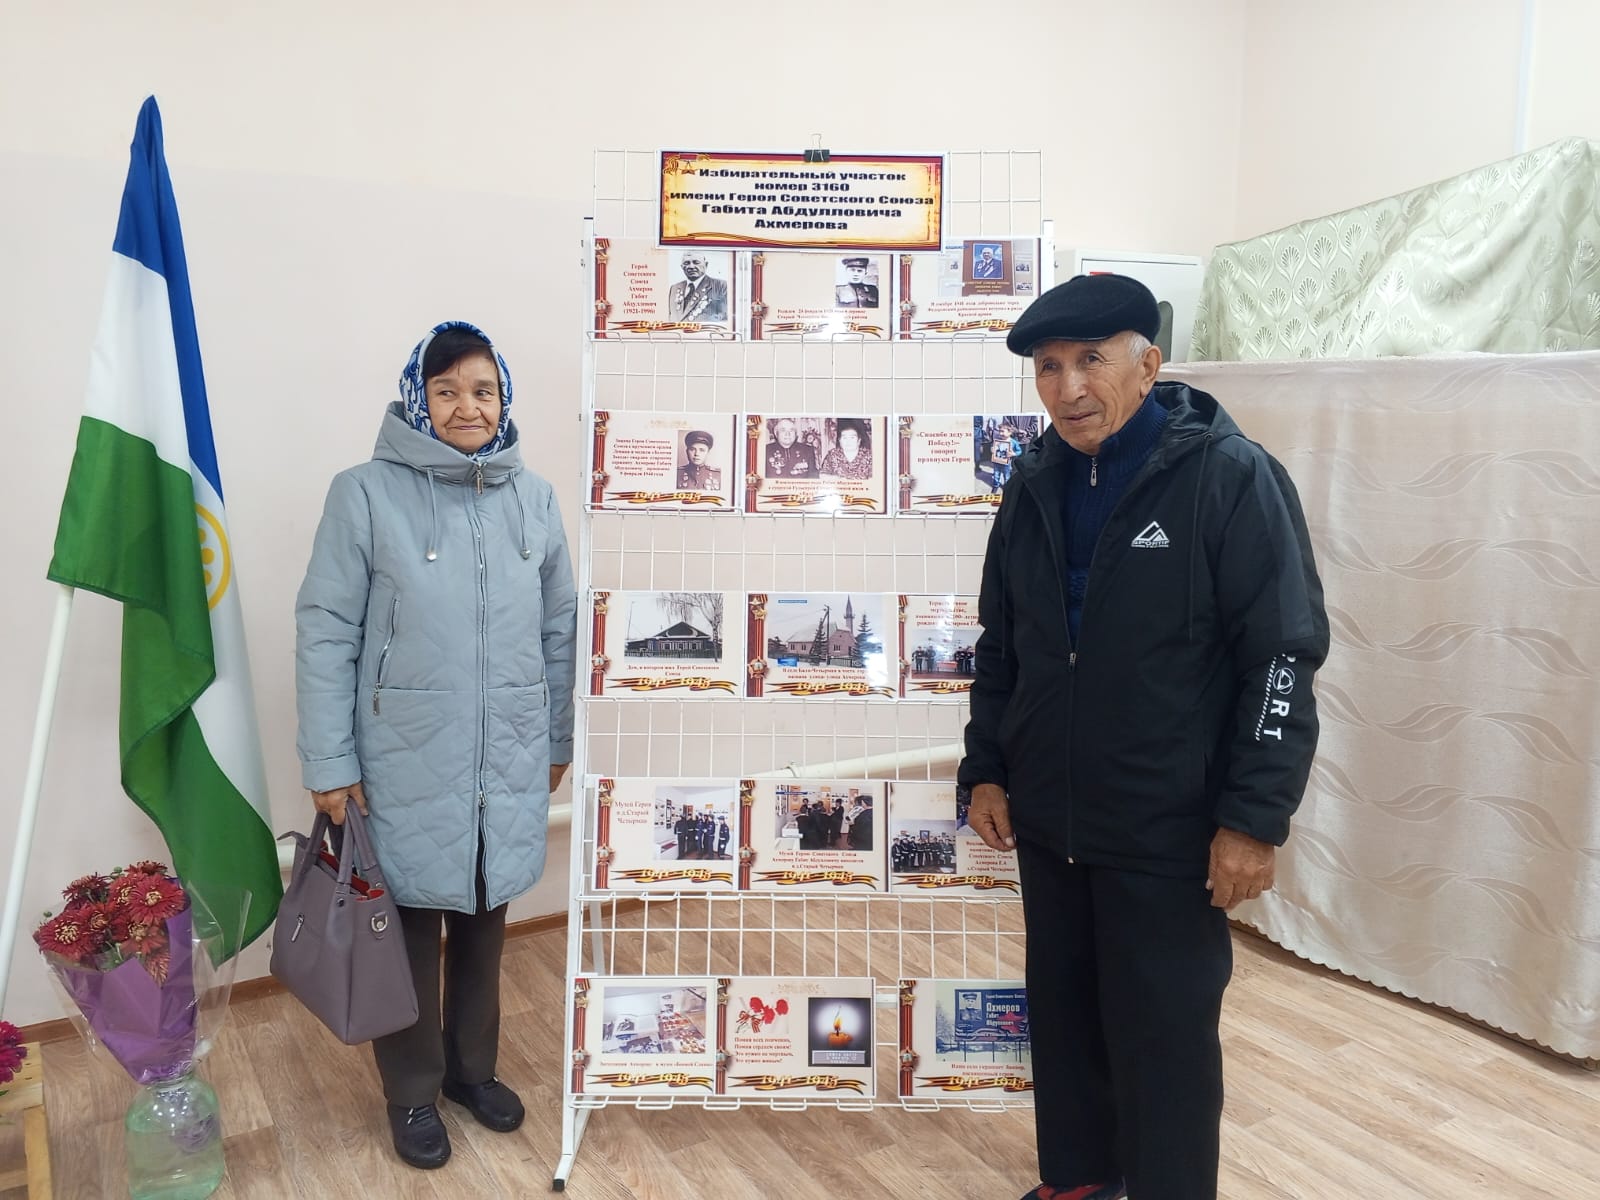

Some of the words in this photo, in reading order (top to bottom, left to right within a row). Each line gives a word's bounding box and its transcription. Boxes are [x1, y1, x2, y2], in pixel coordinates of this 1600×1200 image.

[699, 168, 835, 180] Избирательный
[840, 171, 906, 181] участок
[754, 182, 808, 192] номер
[811, 182, 850, 192] 3160
[670, 192, 725, 200] имени
[729, 193, 777, 203] Героя
[780, 193, 875, 204] Советского
[879, 195, 934, 205] Союза
[701, 204, 767, 215] Габита
[771, 206, 902, 218] Абдулловича
[755, 219, 848, 231] Ахмерова
[635, 801, 652, 809] Героя
[986, 1002, 1020, 1014] Ахмеров
